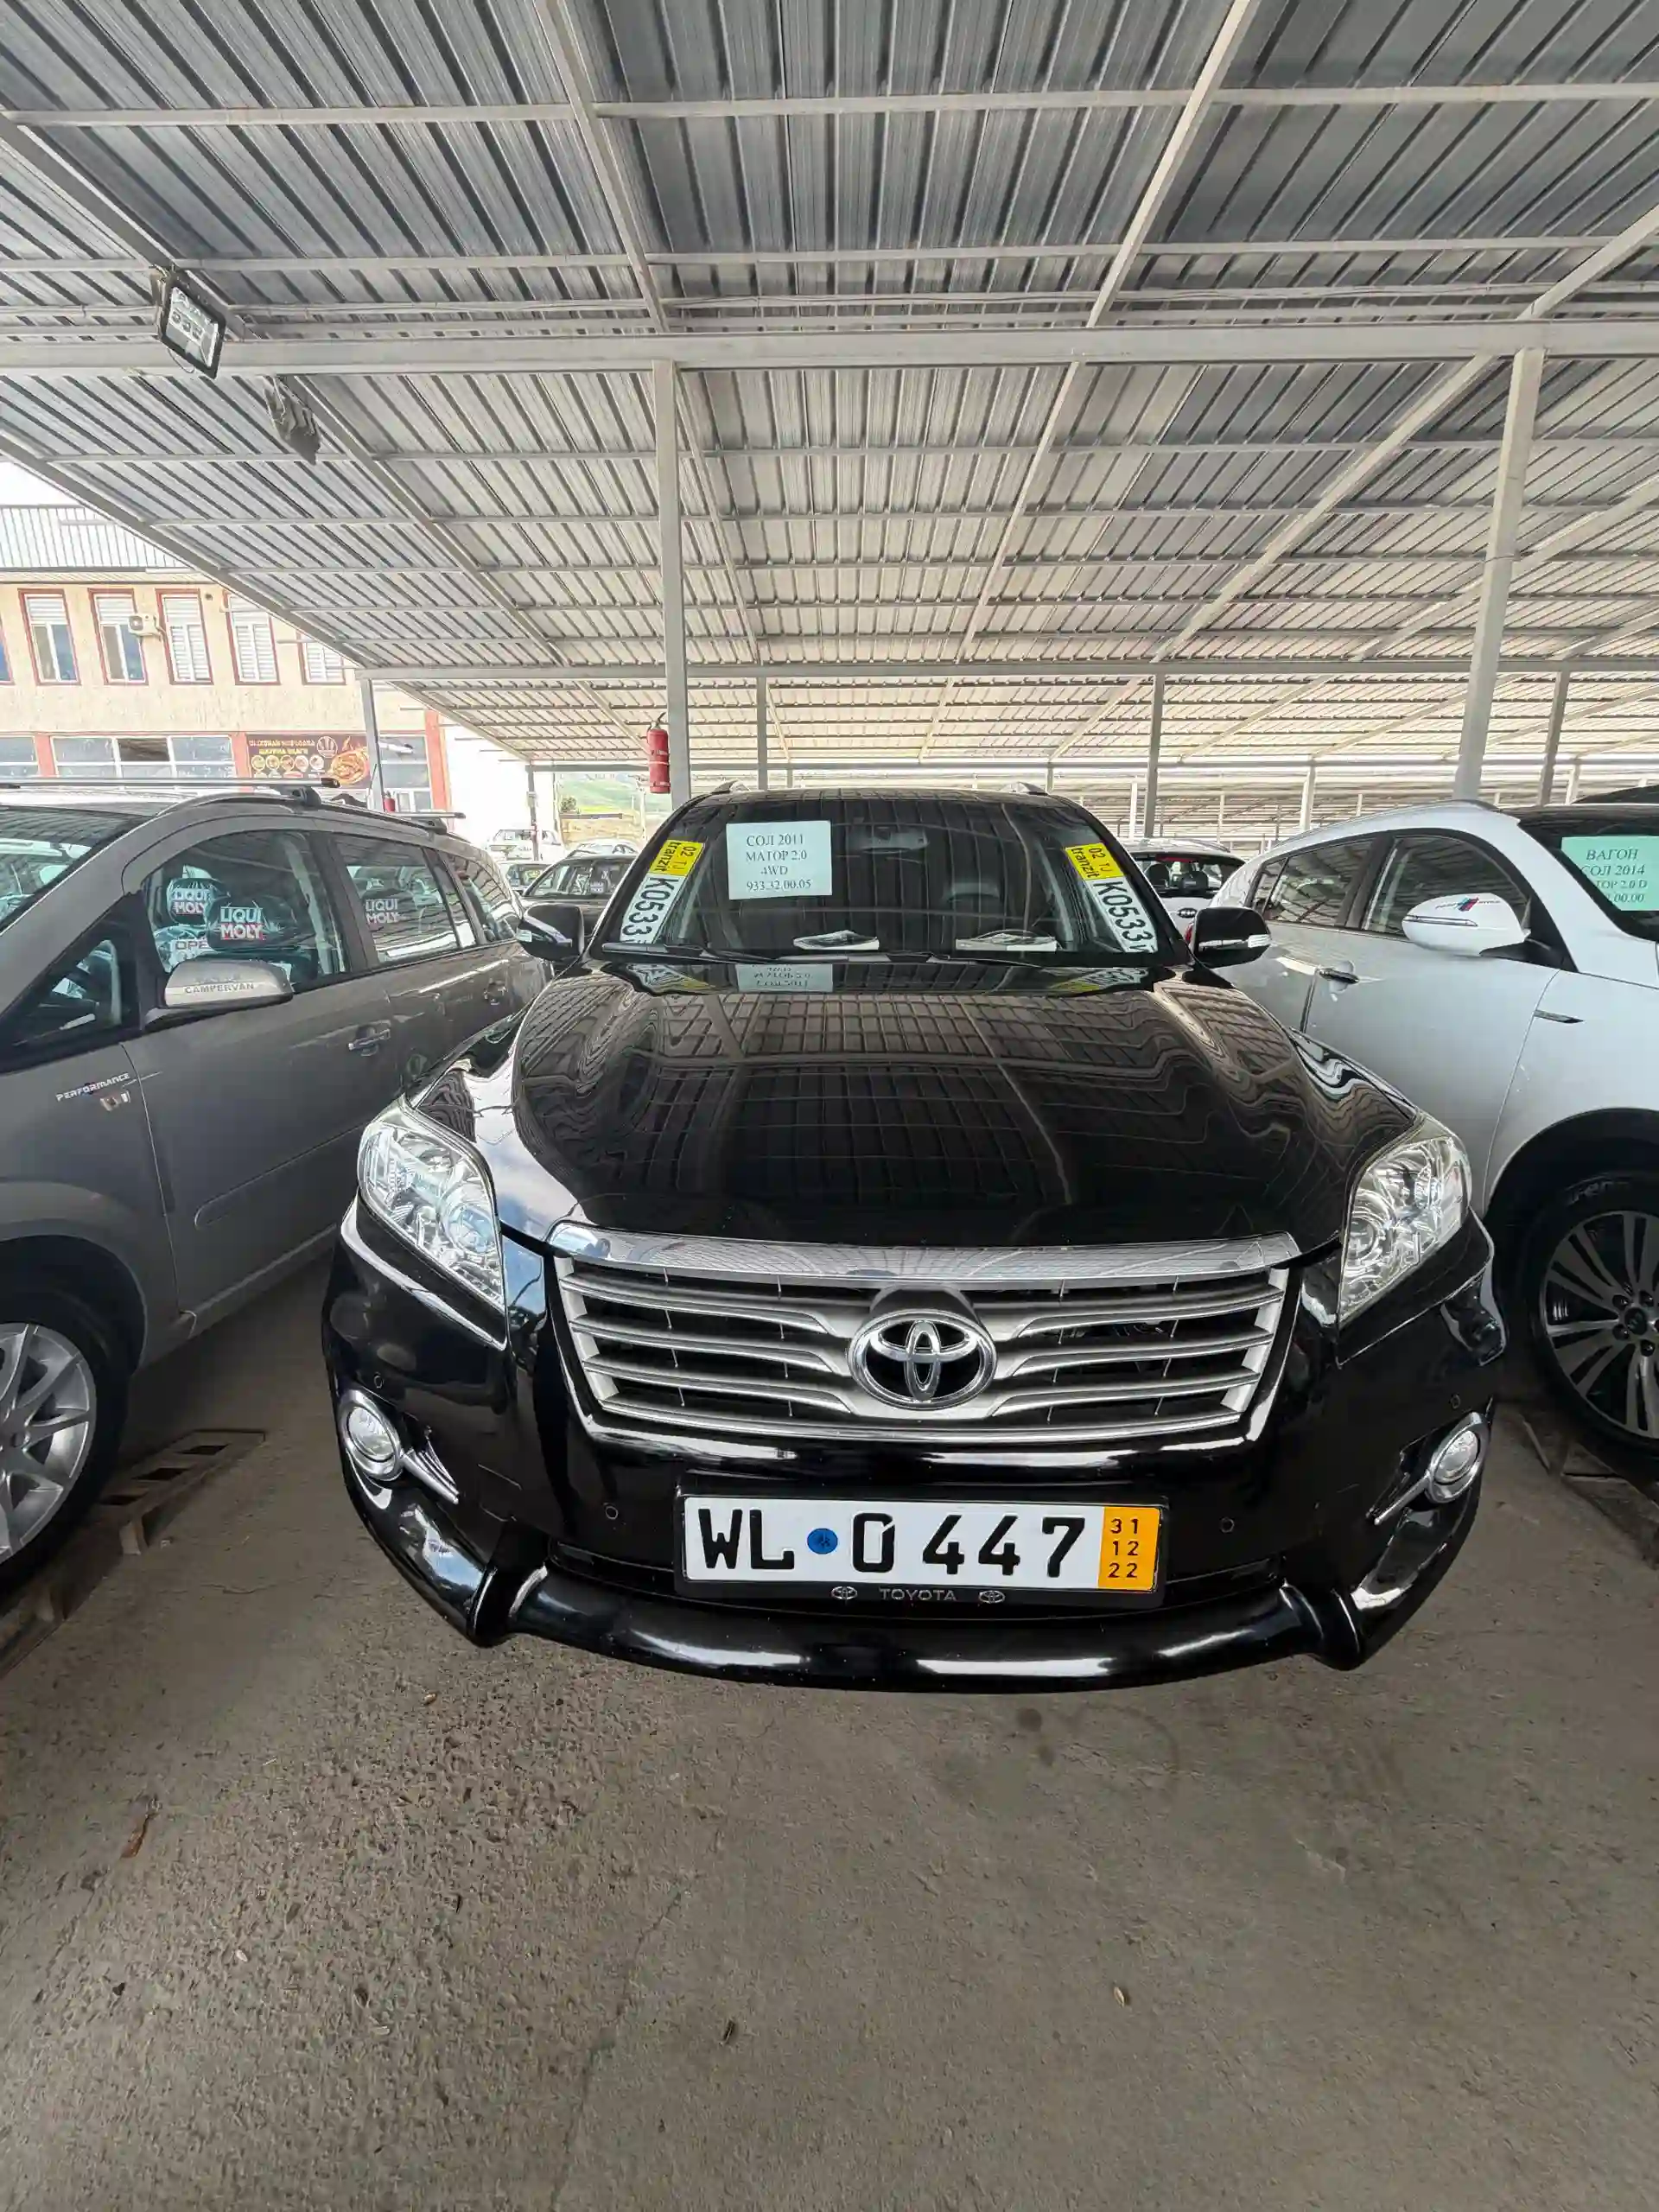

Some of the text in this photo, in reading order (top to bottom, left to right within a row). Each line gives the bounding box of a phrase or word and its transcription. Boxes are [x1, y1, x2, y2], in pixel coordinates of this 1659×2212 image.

[747, 834, 804, 846] СОЛ 2011
[654, 842, 682, 872] tranzit
[1586, 849, 1639, 861] ВАГОН
[1071, 848, 1101, 878] tranzit
[1614, 864, 1645, 875] 2014
[365, 899, 398, 912] LIQUI
[621, 876, 679, 944] K0533
[220, 907, 263, 923] LIQUI
[365, 912, 400, 925] MOLY
[220, 924, 263, 939] MOLY
[184, 982, 255, 994] CAMPERVAN
[55, 1072, 130, 1102] PERFORMANCE
[697, 1508, 795, 1569] WL
[879, 1588, 957, 1601] TOYOTA
